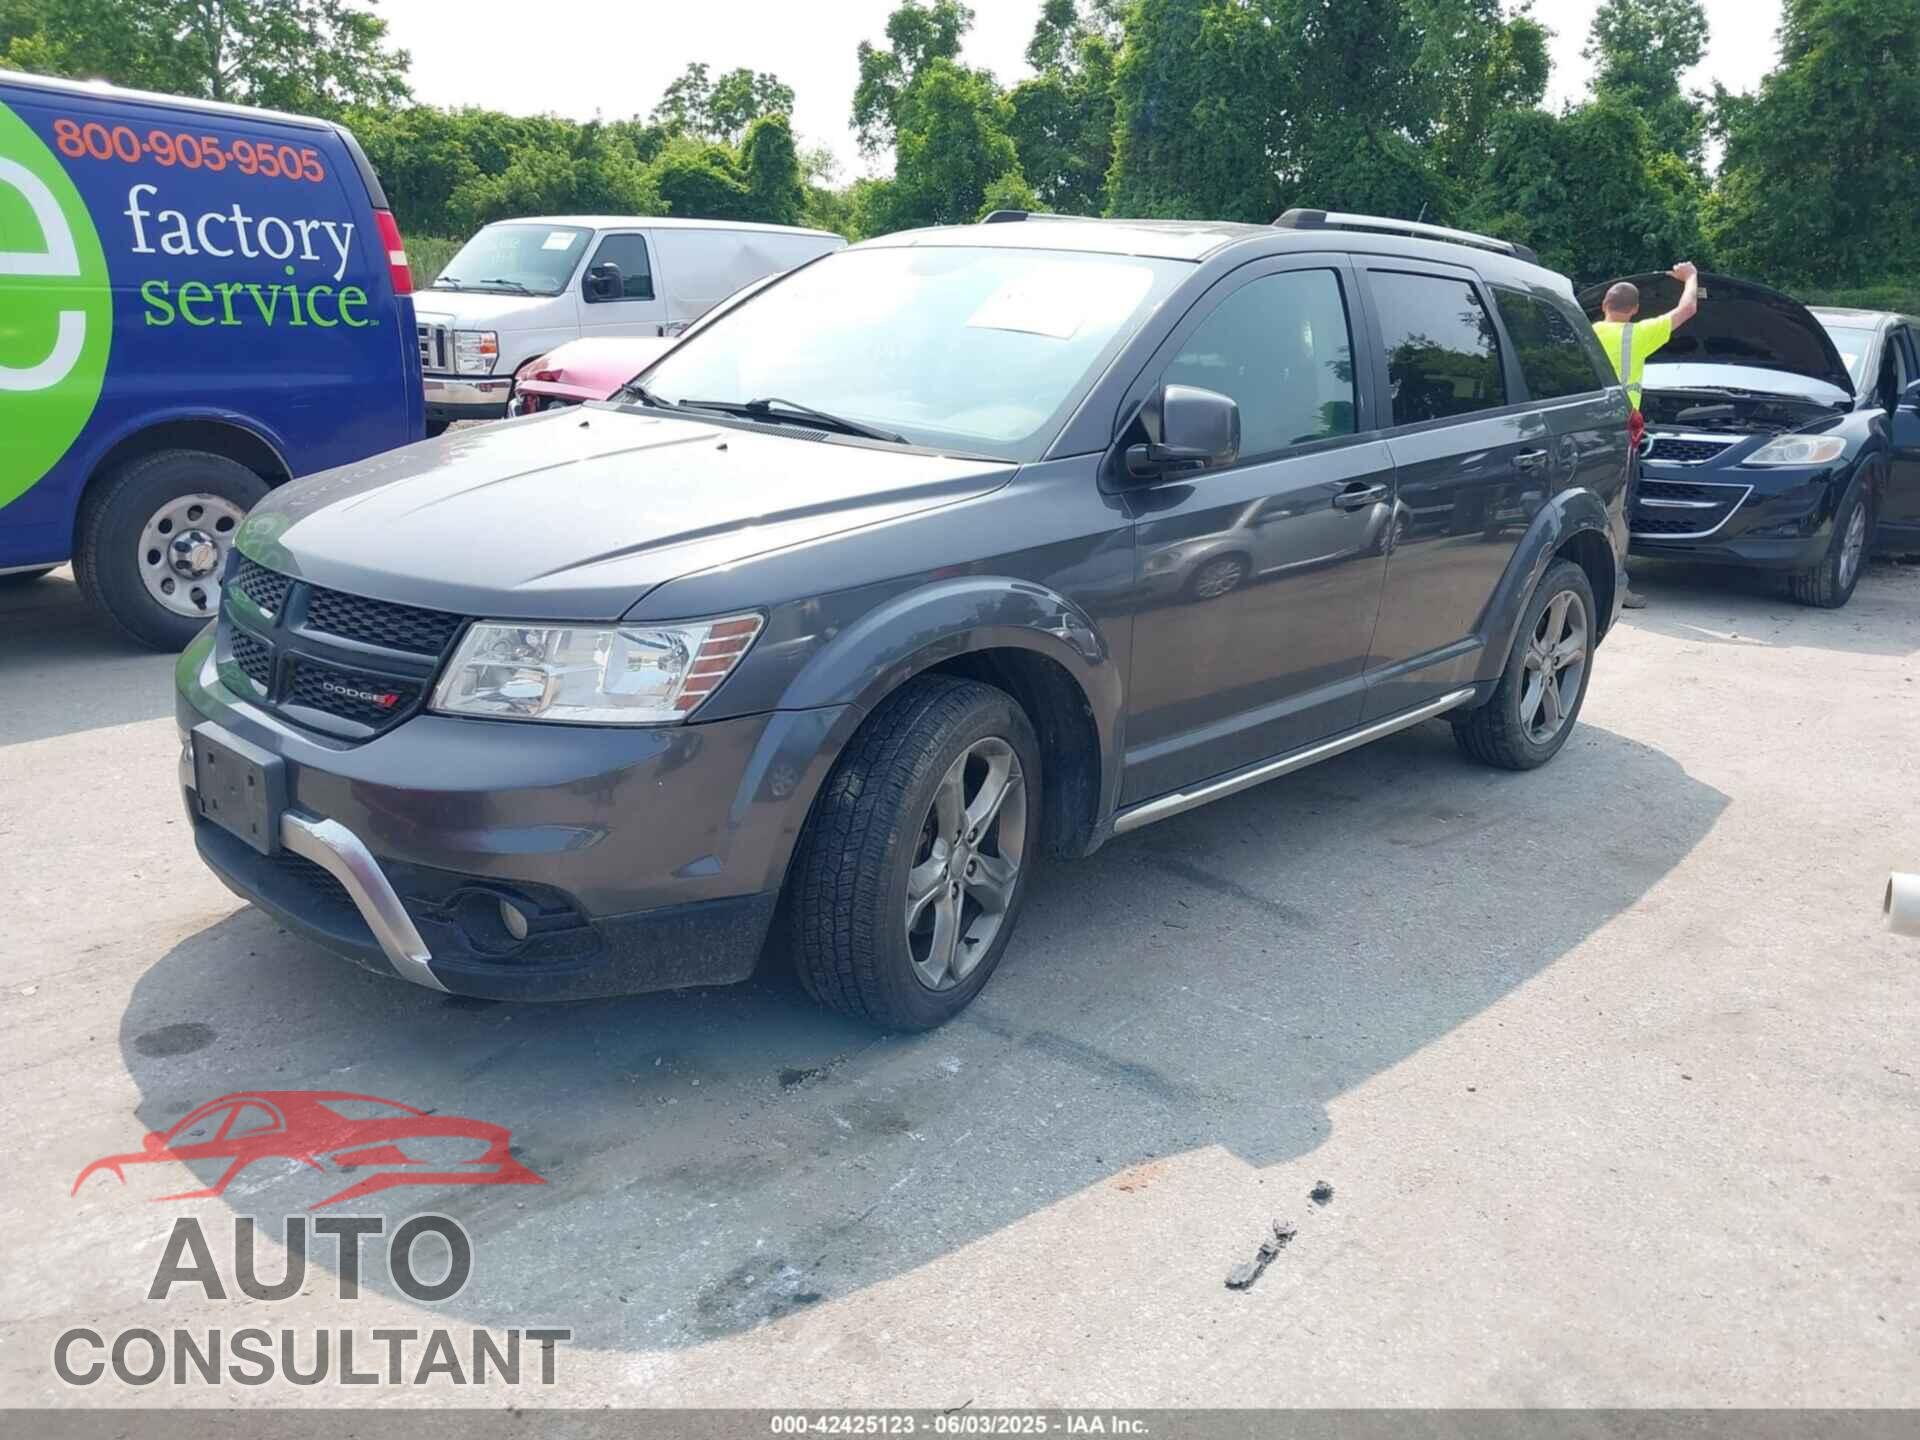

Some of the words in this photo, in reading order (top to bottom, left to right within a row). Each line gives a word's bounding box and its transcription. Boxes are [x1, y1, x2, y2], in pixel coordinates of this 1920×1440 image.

[124, 183, 355, 282] factory
[140, 265, 369, 328] service
[323, 682, 384, 703] DODGE
